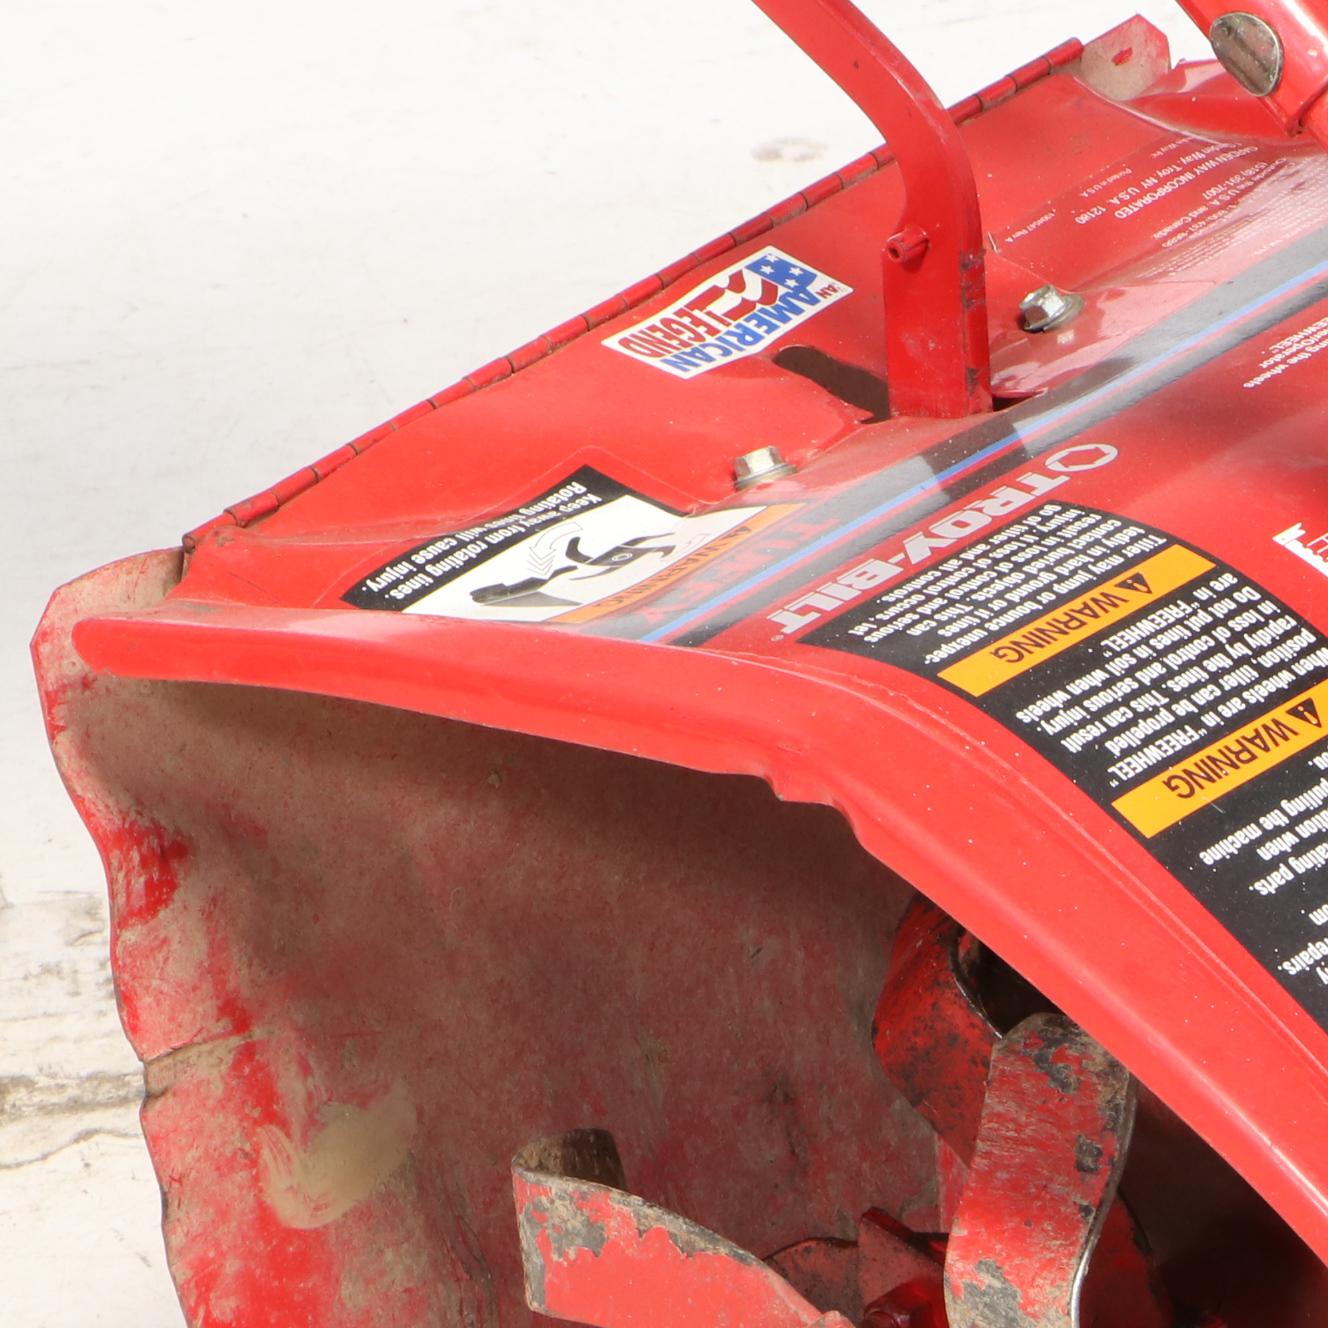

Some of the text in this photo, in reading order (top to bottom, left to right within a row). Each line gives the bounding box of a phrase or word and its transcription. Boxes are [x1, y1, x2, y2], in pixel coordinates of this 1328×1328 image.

[618, 301, 731, 360] LEGEND
[658, 283, 841, 373] AN AMERICAN
[519, 482, 587, 524] Rotating
[551, 488, 602, 512] Keep
[455, 527, 494, 542] will
[484, 519, 526, 544] from
[411, 538, 458, 564] cause
[425, 541, 488, 576] rotating
[362, 561, 417, 592] injury.
[385, 573, 434, 599] tines.
[990, 592, 1129, 663] WARNING
[1242, 670, 1296, 704] wheels
[1200, 711, 1224, 727] in
[1217, 697, 1246, 717] are
[1162, 718, 1299, 799] WARNING
